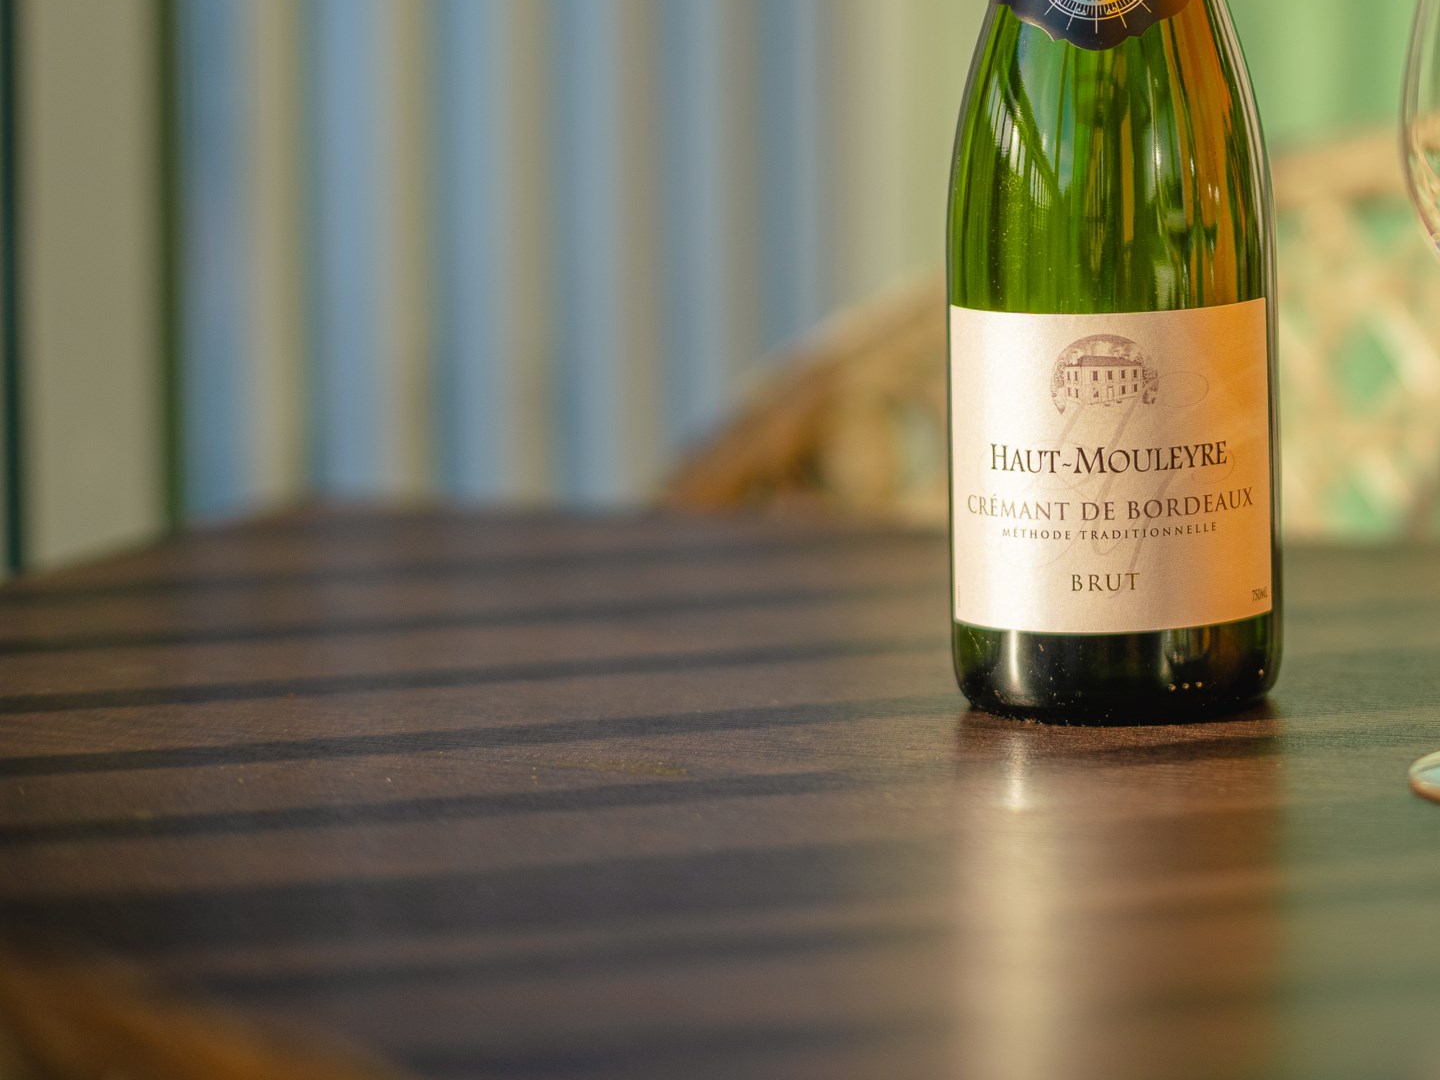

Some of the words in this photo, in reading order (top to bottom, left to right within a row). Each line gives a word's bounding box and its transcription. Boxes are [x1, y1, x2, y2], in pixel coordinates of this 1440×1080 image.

[990, 440, 1228, 474] HAUT-MOULEYRE
[967, 493, 1070, 521] CRÉMANT
[1081, 501, 1116, 521] DE
[1127, 486, 1254, 520] BORDEAUX
[1001, 526, 1071, 541] MÉTHODE
[1079, 521, 1217, 540] TRADITIONNELLE
[1071, 571, 1141, 592] BRUT
